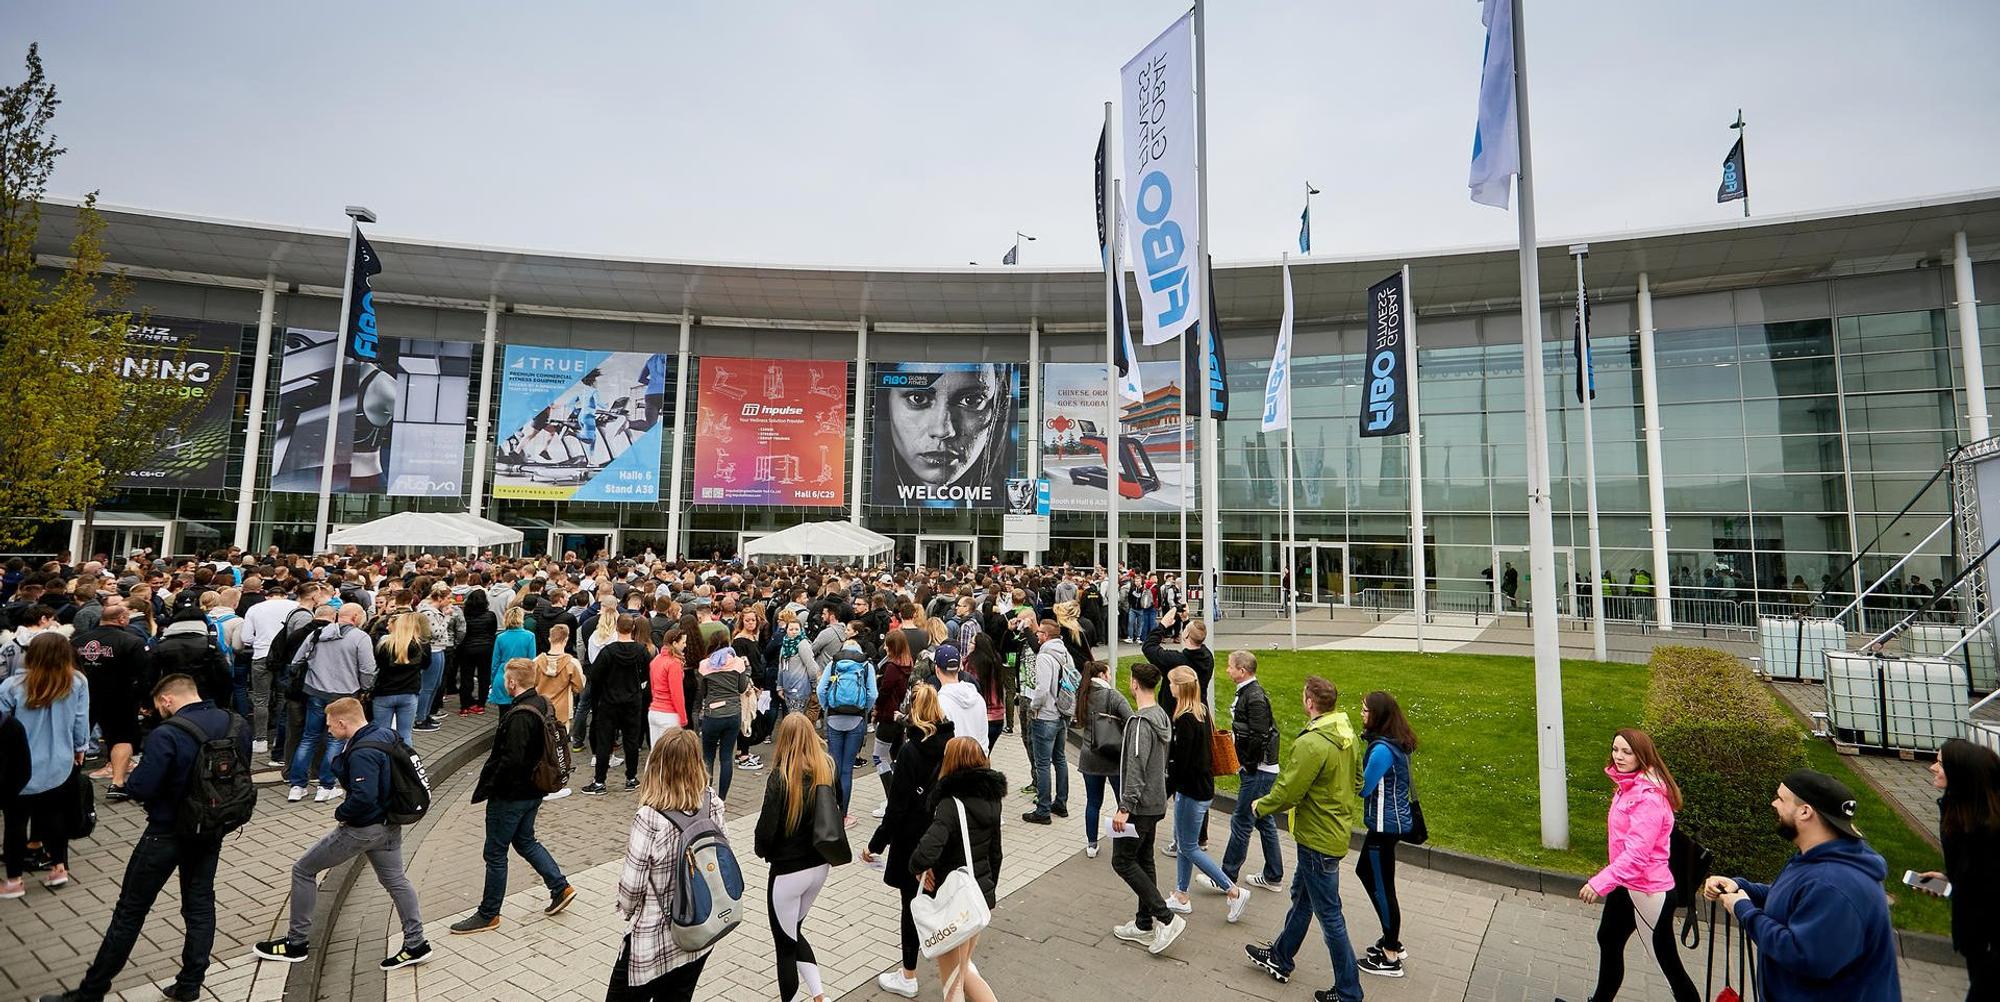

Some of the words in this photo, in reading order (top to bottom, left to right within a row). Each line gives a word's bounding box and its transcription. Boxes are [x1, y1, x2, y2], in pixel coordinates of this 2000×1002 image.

[529, 357, 585, 372] TRUE
[883, 375, 908, 385] FIBO
[619, 470, 643, 480] Halle
[645, 471, 652, 480] 6
[604, 484, 633, 494] Stand
[897, 484, 992, 501] WELCOME
[794, 490, 811, 498] Hall
[812, 490, 835, 499] 6/C29
[924, 923, 958, 948] adidas
